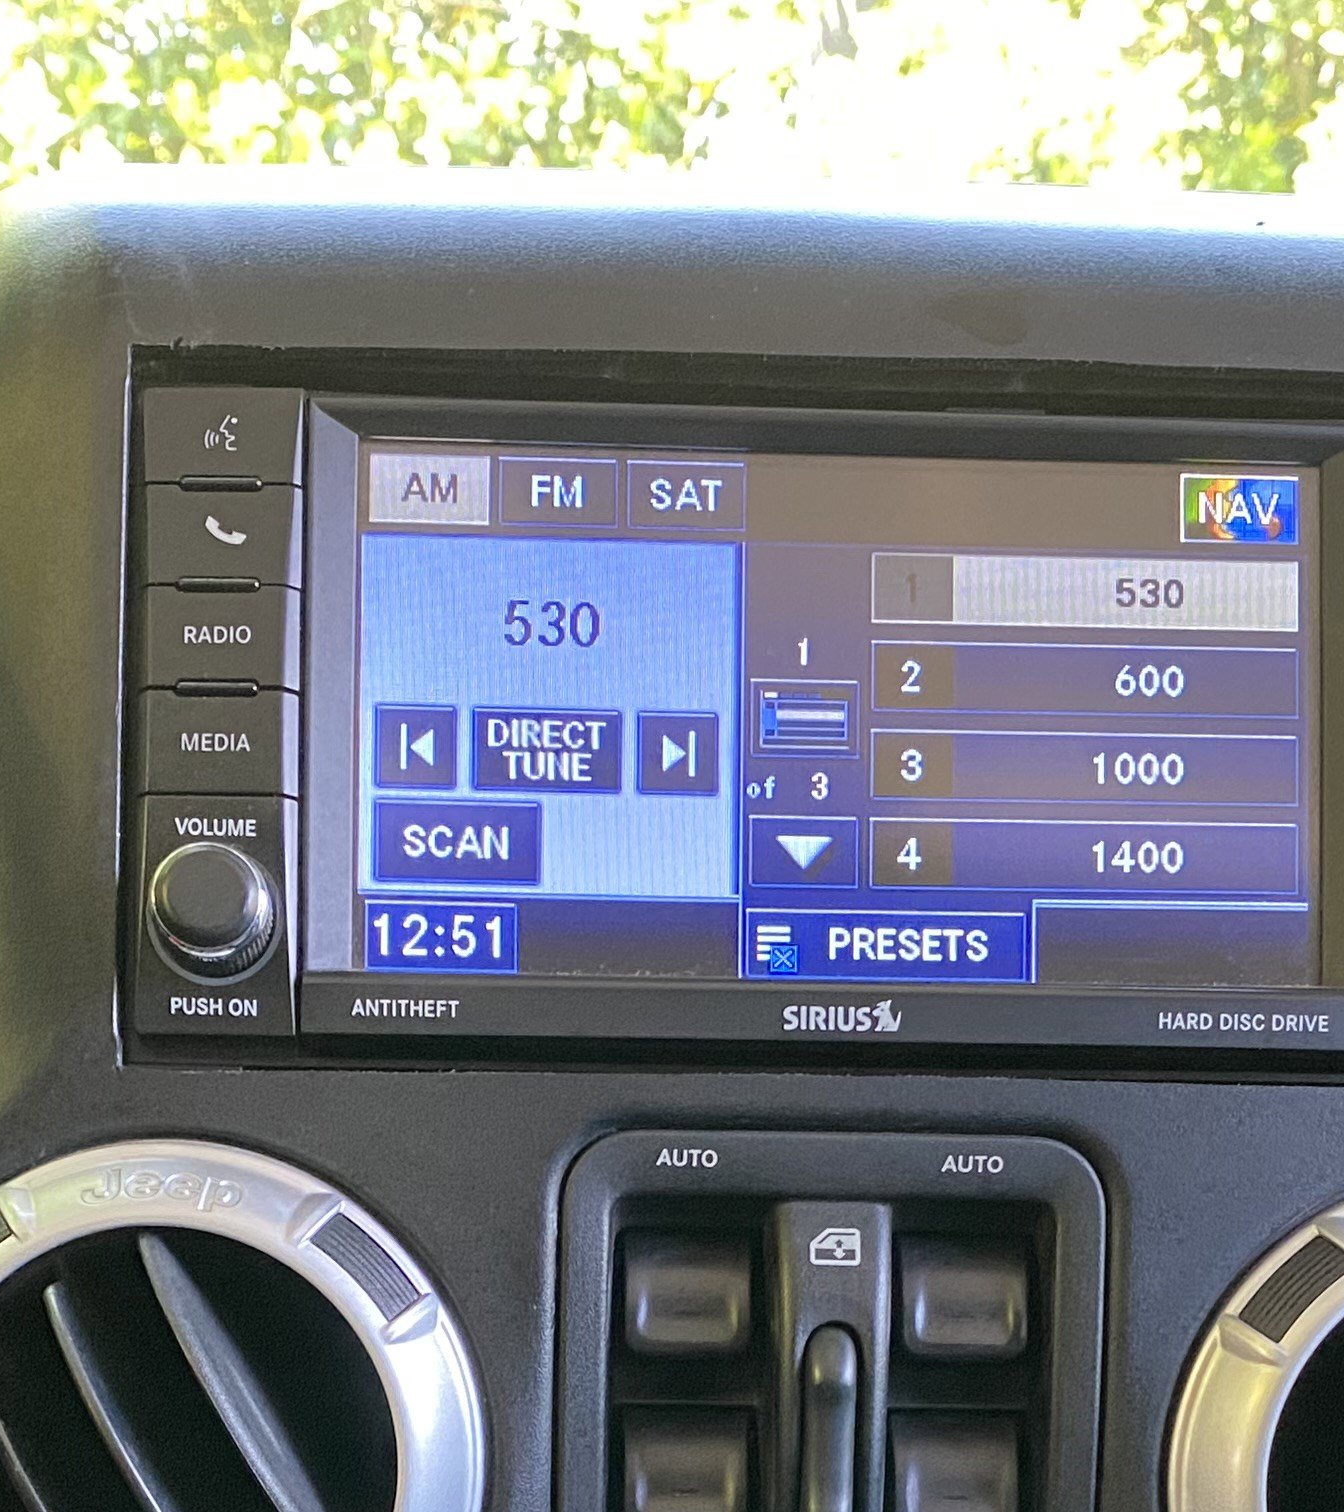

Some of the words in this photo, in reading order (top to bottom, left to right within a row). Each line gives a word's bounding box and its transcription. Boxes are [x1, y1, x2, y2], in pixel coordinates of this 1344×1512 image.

[400, 472, 458, 505] AM
[531, 474, 583, 509] FM
[650, 478, 723, 512] SAT
[1197, 491, 1280, 525] NAV
[1115, 577, 1184, 609] 530
[183, 625, 252, 644] RADIO
[503, 599, 600, 648] 530
[797, 637, 808, 666] 1
[900, 660, 921, 693] 2
[1115, 664, 1185, 698] 600
[181, 732, 251, 752] MEDIA
[487, 717, 607, 750] DIRECT
[501, 750, 593, 782] TUNE
[900, 748, 923, 782] 3
[1092, 751, 1184, 786] 1000
[746, 775, 776, 799] of
[810, 771, 829, 801] 3
[174, 816, 257, 837] VOLUME
[402, 824, 509, 861] SCAN
[896, 837, 922, 871] 4
[1091, 840, 1184, 874] 1400
[373, 912, 501, 959] 12:51
[828, 926, 989, 962] PRESETS
[169, 996, 221, 1017] PUSH
[227, 998, 258, 1017] ON
[351, 998, 460, 1019] ANTITHEFT
[782, 1005, 872, 1032] SIRIUS
[1158, 1011, 1213, 1031] HARD
[1219, 1013, 1266, 1032] DISC
[1271, 1014, 1329, 1033] DRIVE
[655, 1148, 719, 1168] AUTO
[940, 1154, 1004, 1174] AUTO
[80, 1167, 244, 1212] Jeep
